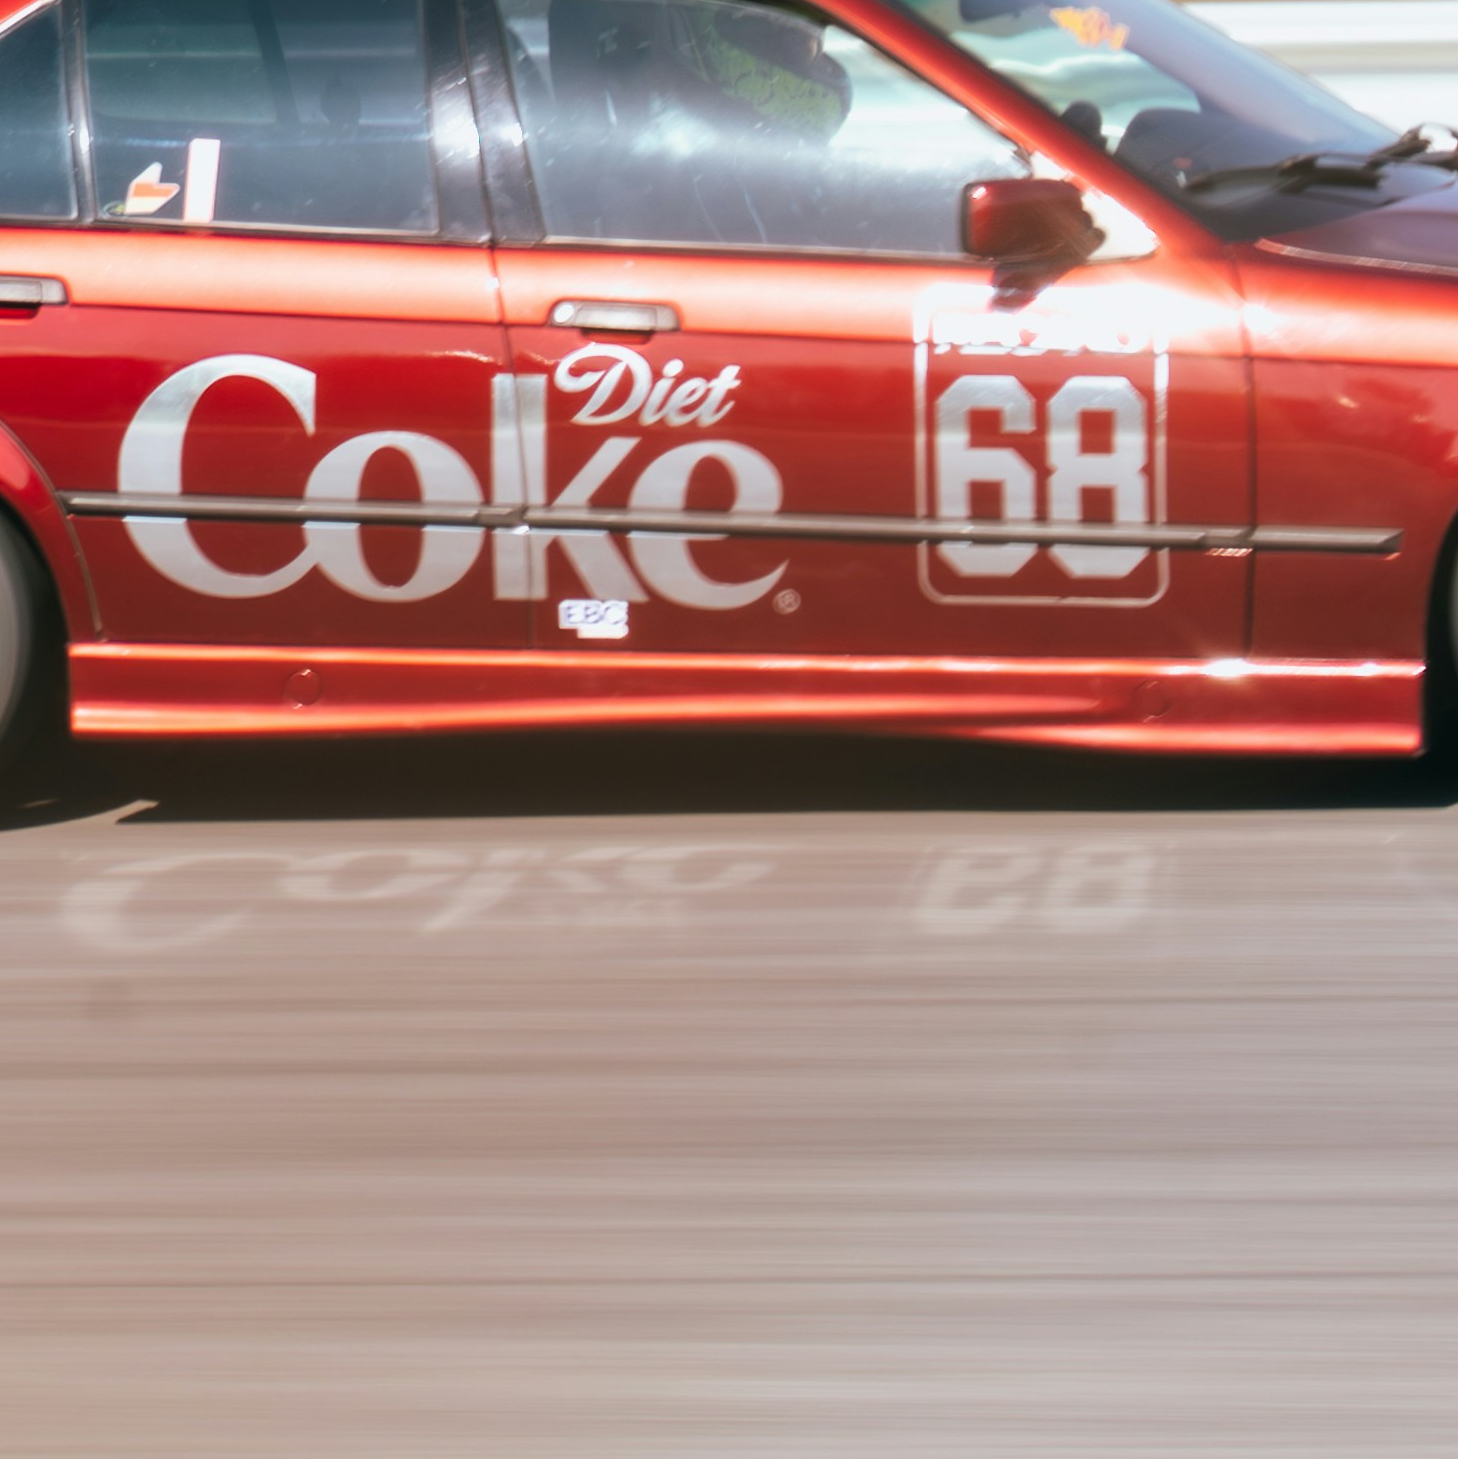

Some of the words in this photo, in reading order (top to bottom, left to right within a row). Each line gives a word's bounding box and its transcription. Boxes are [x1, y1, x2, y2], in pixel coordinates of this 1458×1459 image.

[118, 354, 790, 611] Coke
[554, 342, 741, 428] Diet
[935, 374, 1149, 579] 68
